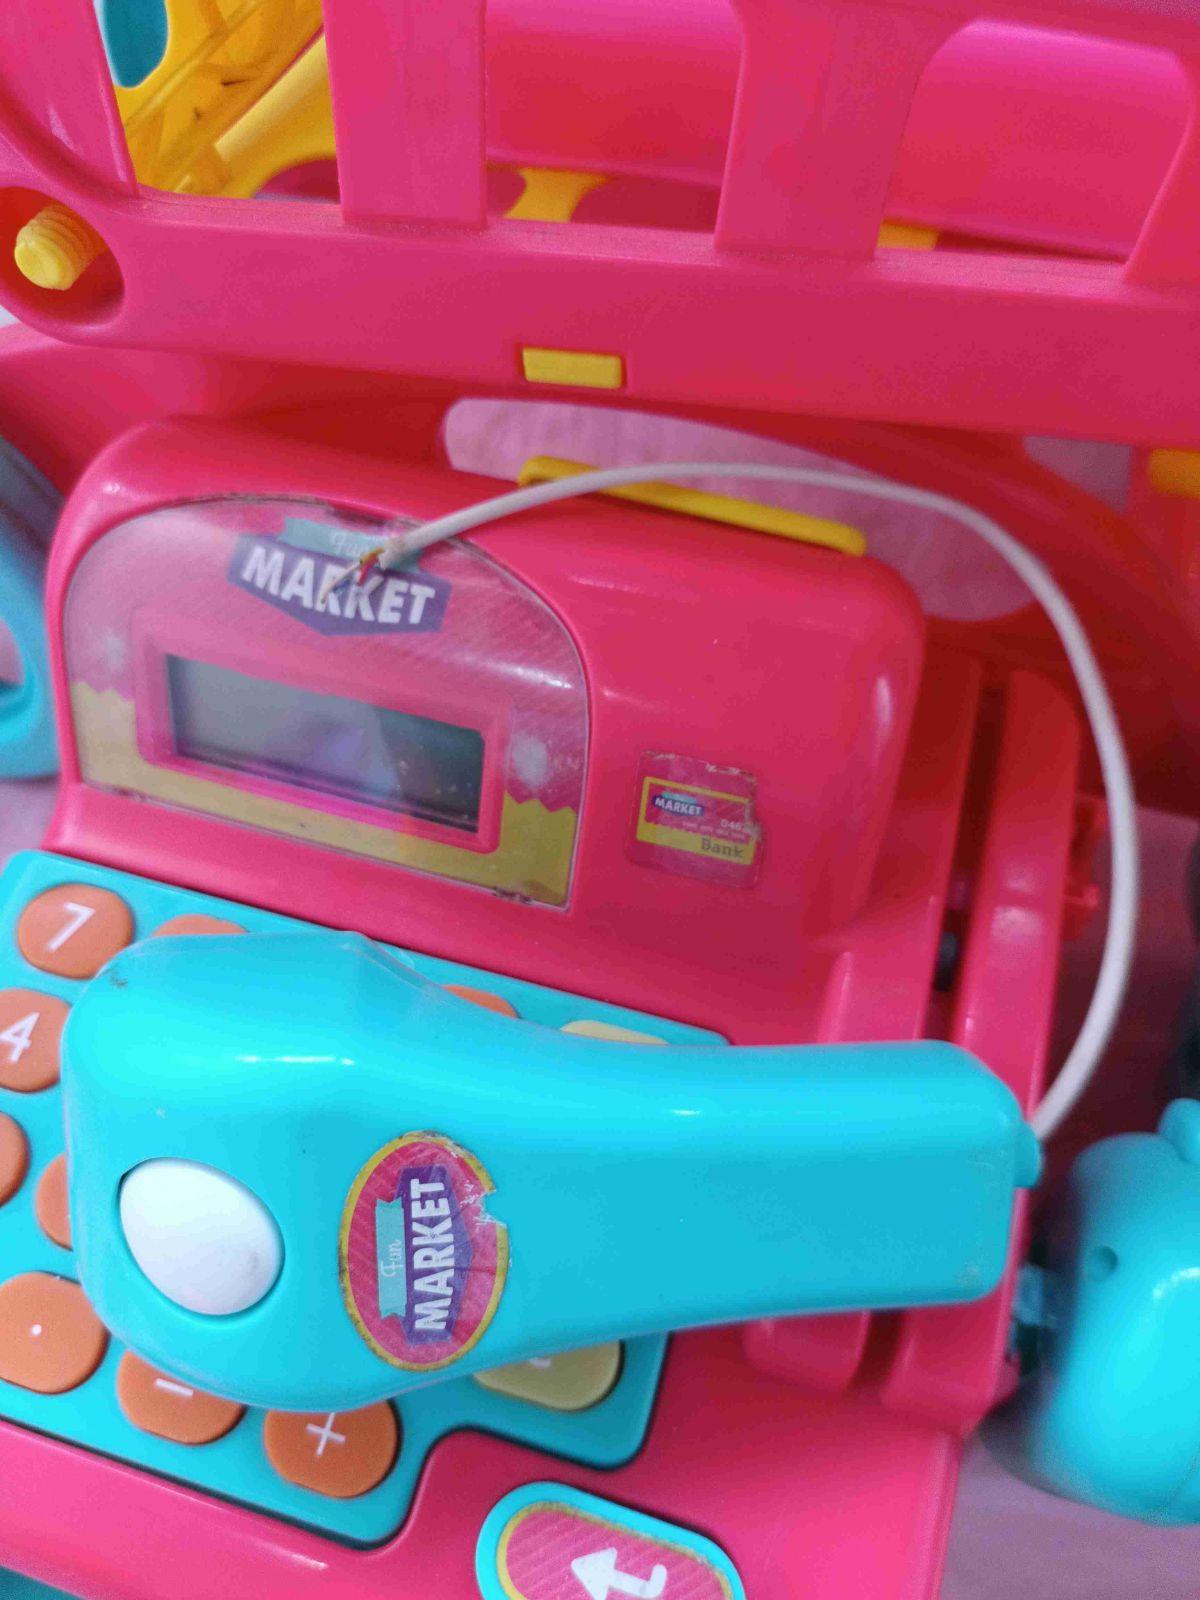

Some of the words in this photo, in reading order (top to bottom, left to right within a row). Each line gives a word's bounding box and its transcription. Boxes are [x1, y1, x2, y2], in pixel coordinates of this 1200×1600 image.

[240, 545, 437, 625] MARKET
[654, 797, 703, 815] MARKET
[701, 837, 744, 859] Bank
[48, 900, 96, 953] 7
[0, 1011, 40, 1064] 4
[380, 1238, 404, 1278] Fun
[410, 1178, 455, 1331] MARKET
